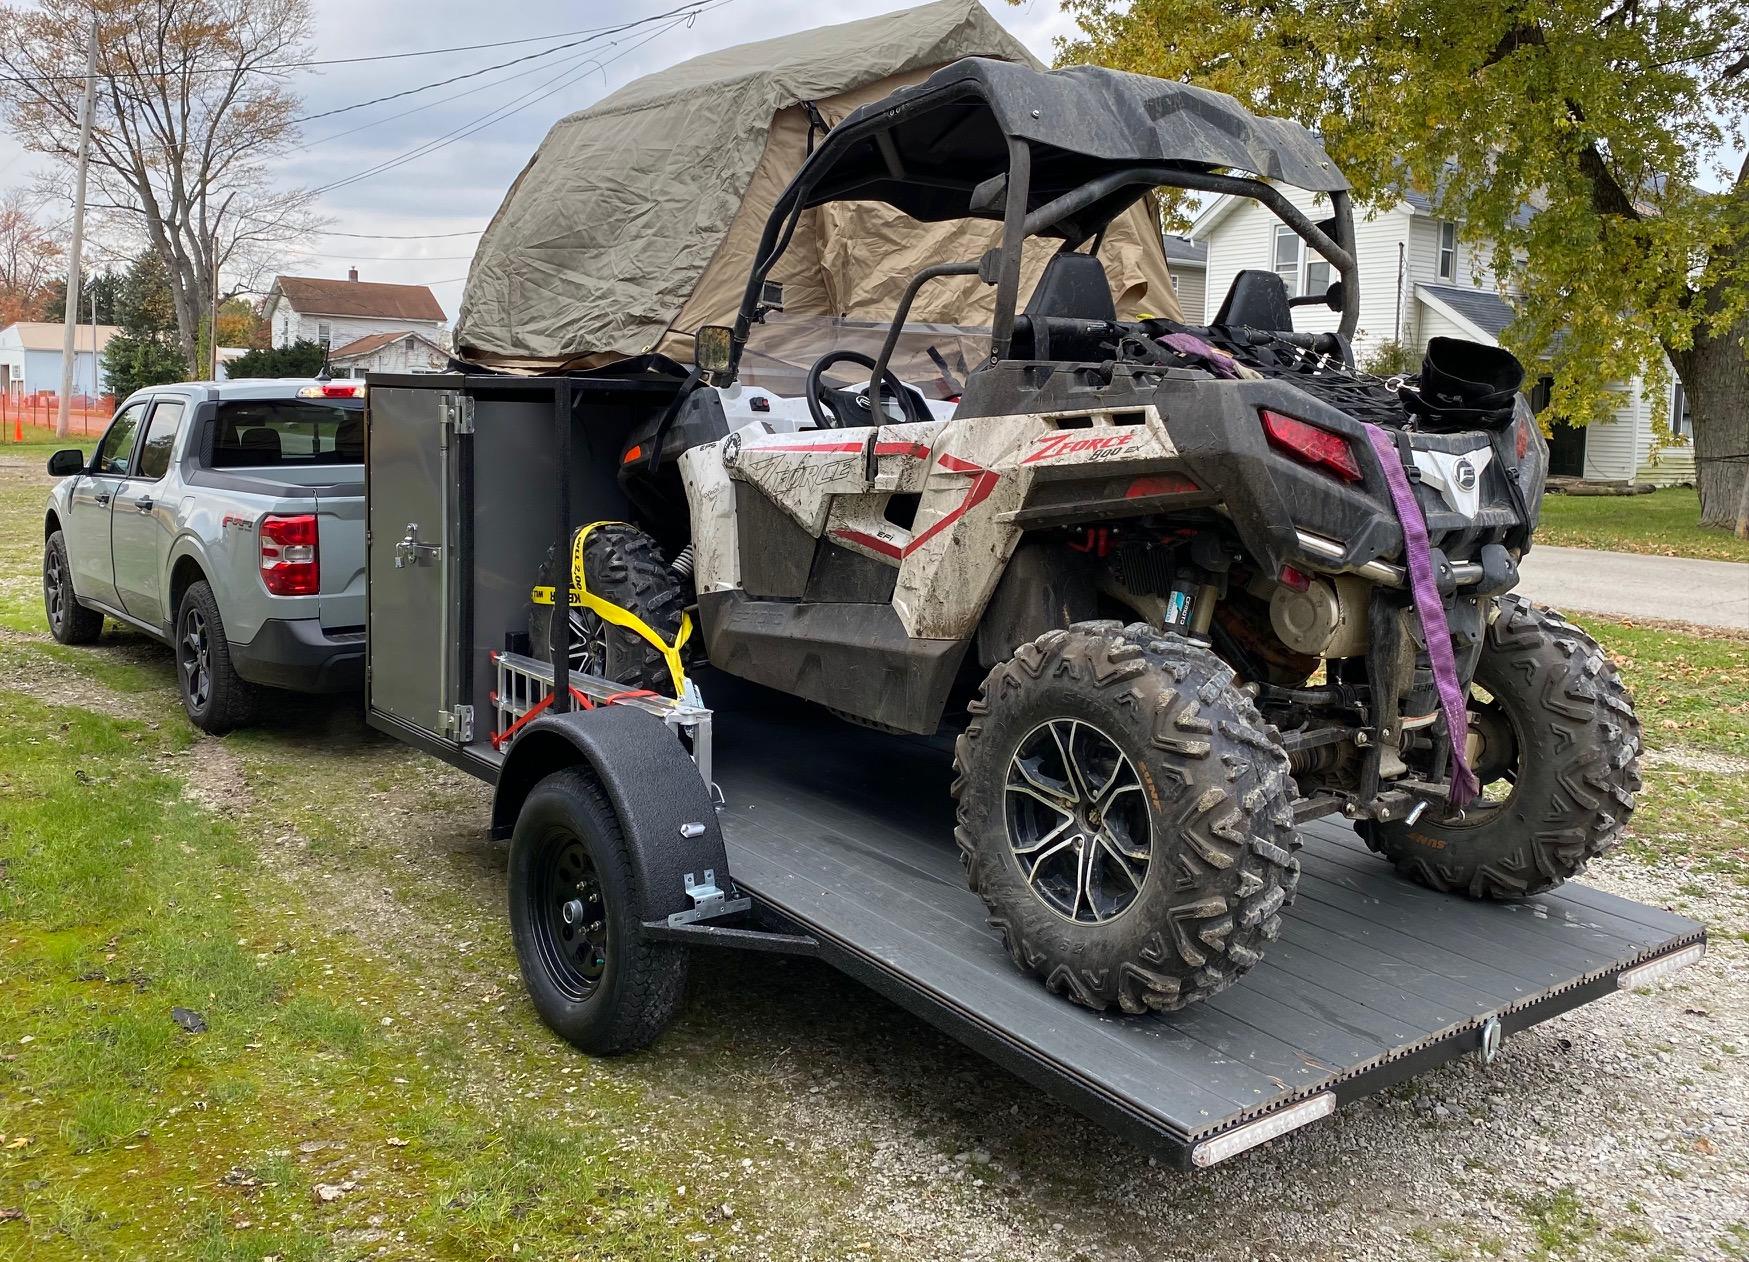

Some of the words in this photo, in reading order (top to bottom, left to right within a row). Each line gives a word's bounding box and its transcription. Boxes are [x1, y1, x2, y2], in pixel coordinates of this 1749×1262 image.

[1089, 446, 1122, 461] 800
[1124, 444, 1142, 453] EX
[876, 530, 895, 542] EFI
